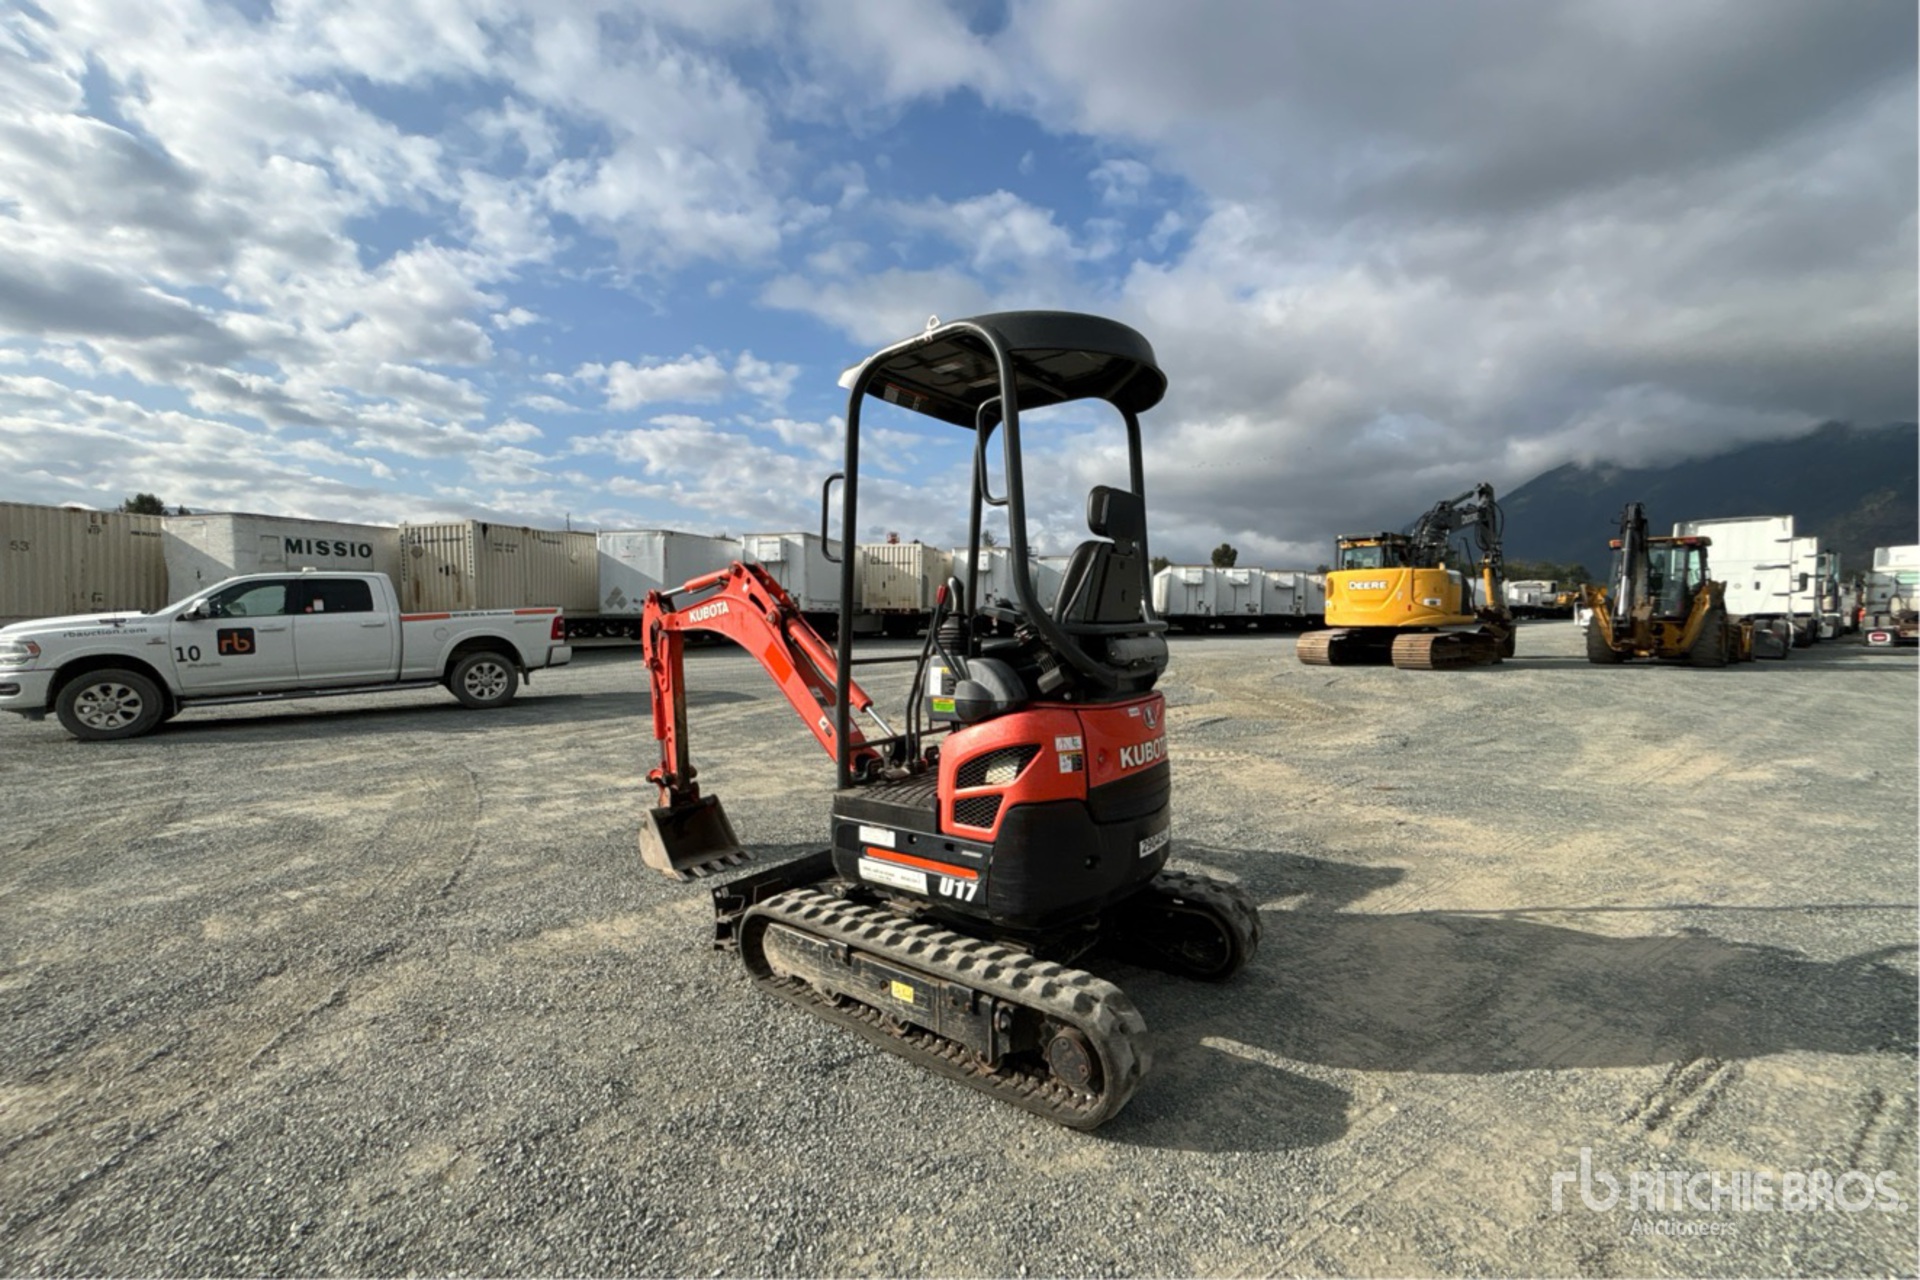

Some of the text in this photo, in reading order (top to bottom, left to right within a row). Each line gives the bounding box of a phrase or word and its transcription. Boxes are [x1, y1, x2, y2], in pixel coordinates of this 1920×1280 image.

[285, 538, 373, 558] MISSIO
[1348, 580, 1388, 591] DEERE
[688, 600, 730, 623] KUBOTA
[63, 627, 149, 639] rbauction.com
[220, 632, 251, 653] rb
[174, 645, 202, 663] 10
[938, 876, 979, 902] U17
